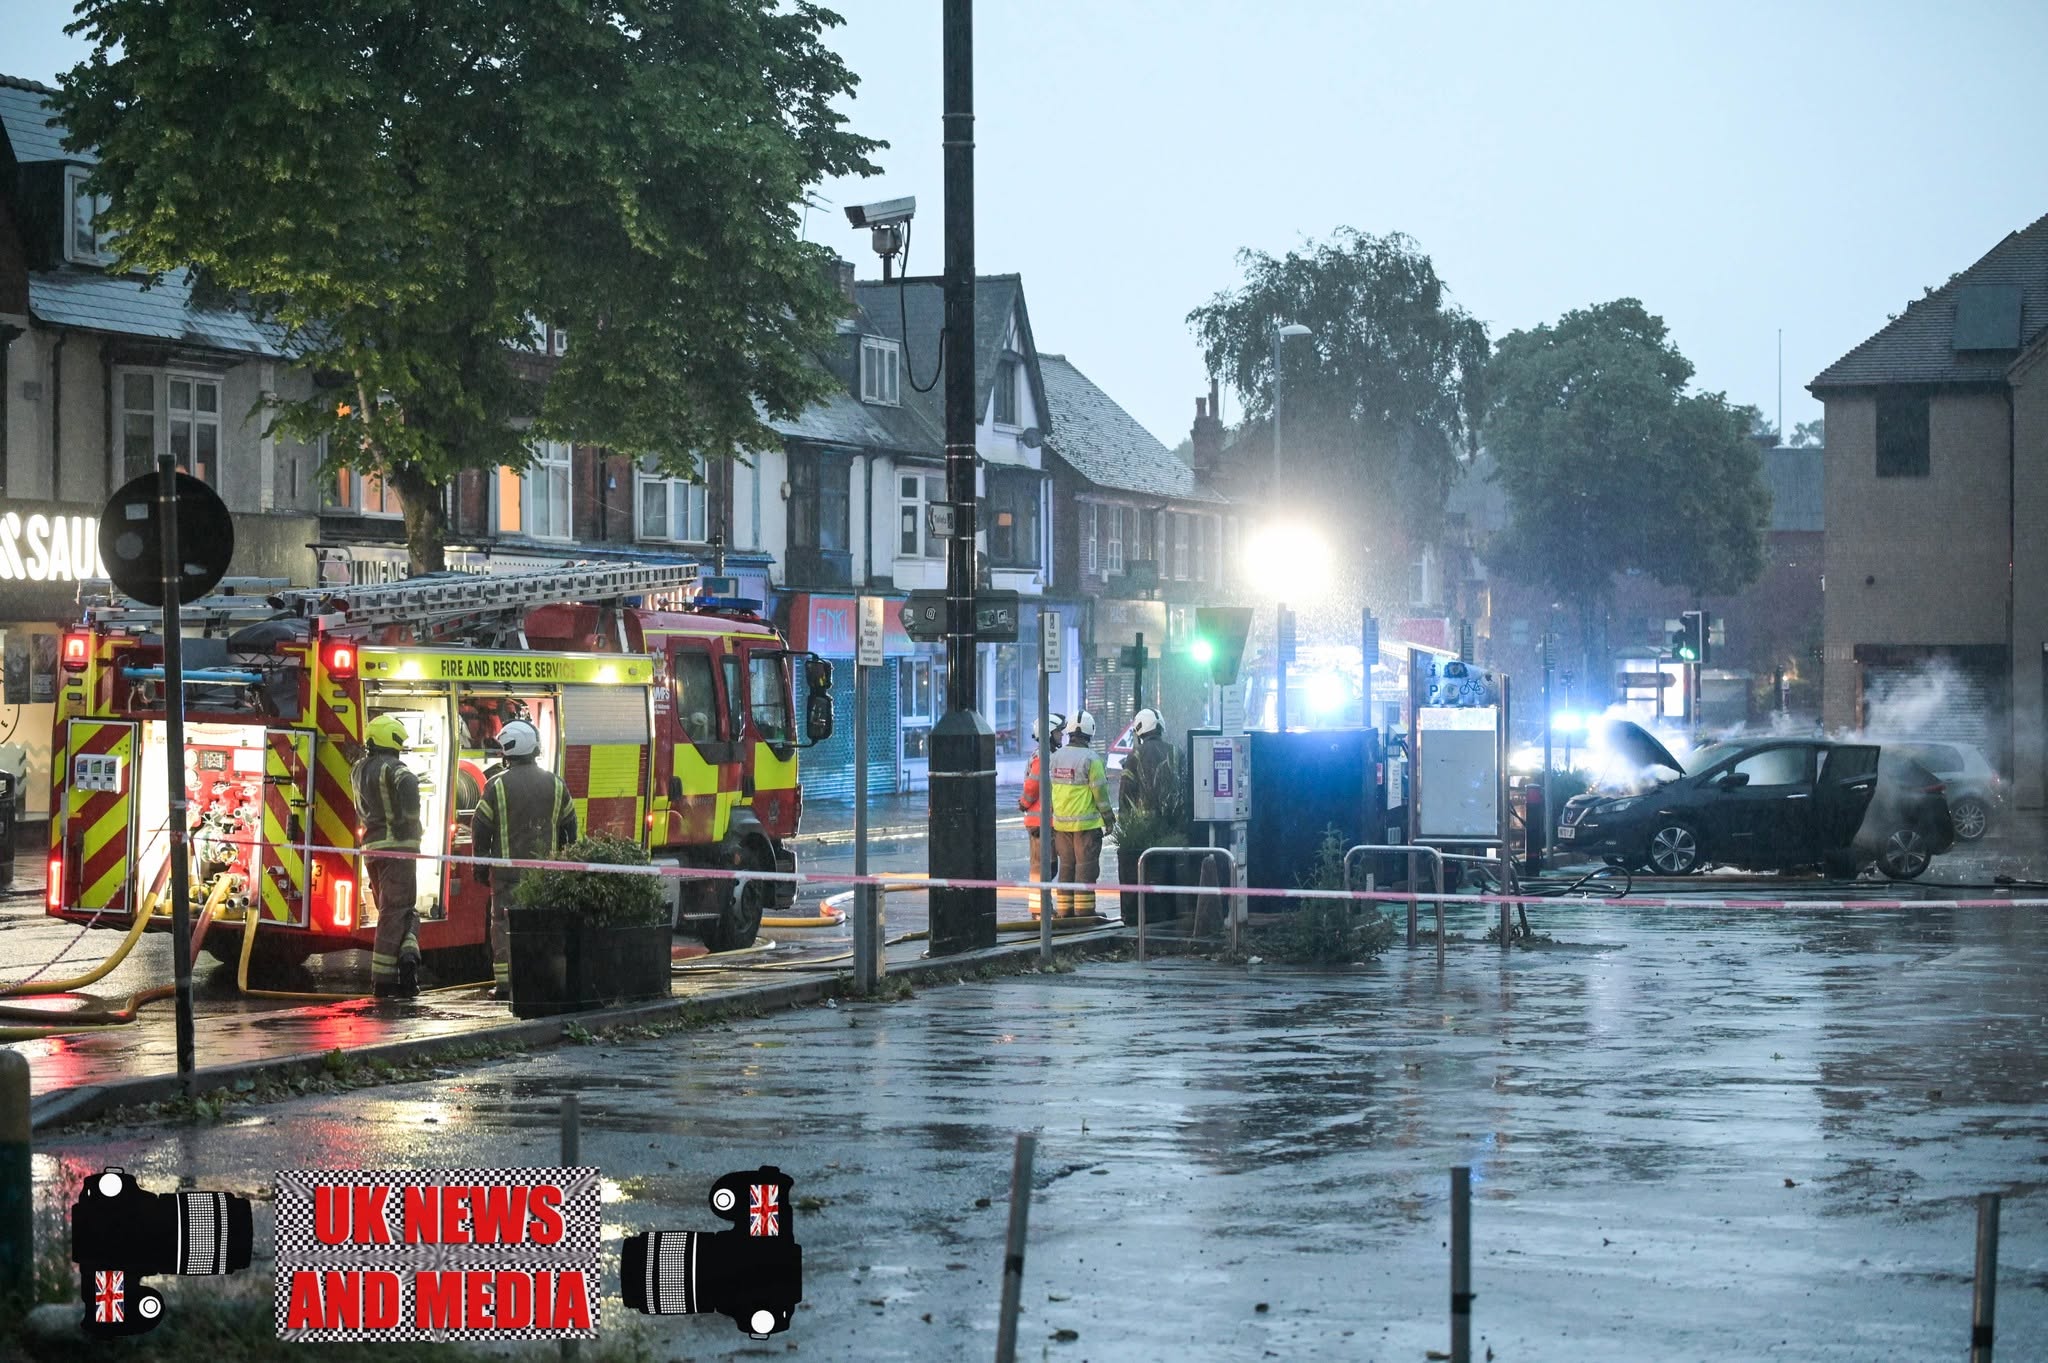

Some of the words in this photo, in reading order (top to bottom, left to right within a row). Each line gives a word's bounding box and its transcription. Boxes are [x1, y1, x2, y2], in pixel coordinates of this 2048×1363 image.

[27, 514, 110, 581] SAU
[441, 659, 463, 677] FIRE
[466, 660, 490, 677] AND
[493, 660, 532, 678] RESCUE
[535, 661, 576, 679] SERVICE
